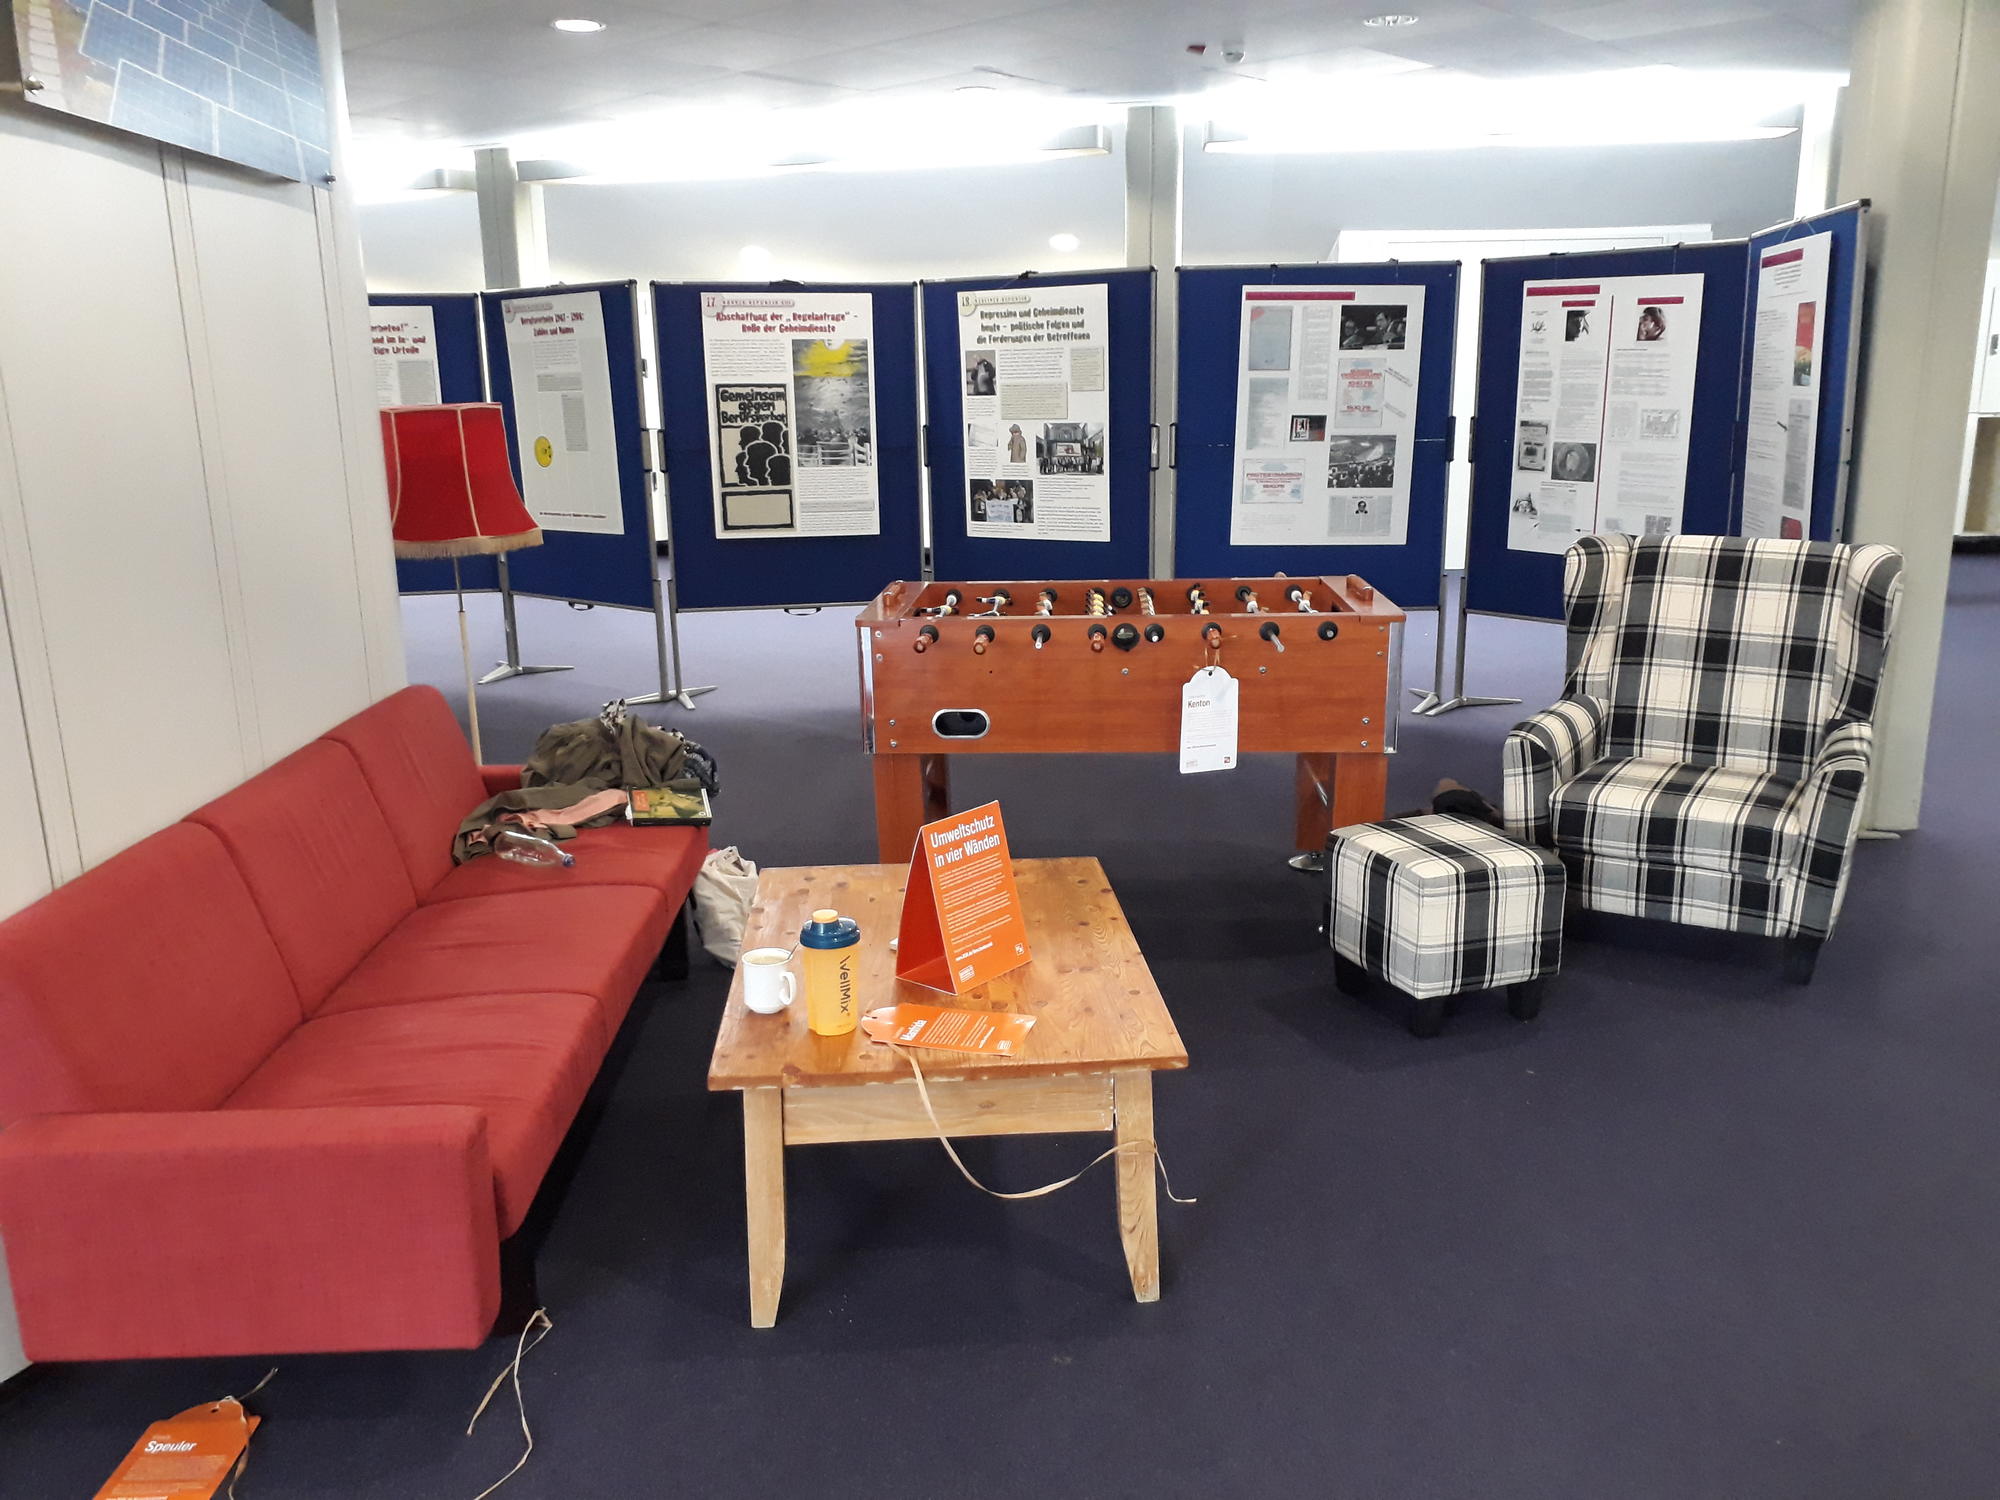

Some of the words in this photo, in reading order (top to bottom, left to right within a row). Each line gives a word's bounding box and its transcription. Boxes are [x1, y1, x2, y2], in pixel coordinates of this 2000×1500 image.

[706, 296, 716, 308] 17
[715, 311, 768, 322] Abschaffung
[770, 311, 783, 321] der
[1018, 307, 1031, 318] und
[1033, 306, 1085, 318] Geheimdienste
[763, 323, 777, 333] der
[779, 323, 836, 334] Geheimdienste
[980, 321, 1001, 332] heute
[1010, 320, 1045, 332] politische
[1046, 319, 1070, 331] Folgen
[1071, 319, 1085, 329] und
[412, 335, 427, 344] und
[976, 334, 987, 344] die
[988, 333, 1032, 345] Forderungen
[1033, 332, 1045, 343] der
[1046, 331, 1091, 343] Betroffenen
[720, 388, 785, 402] Gemeinsam
[738, 400, 776, 414] gegen
[1187, 699, 1211, 709] Kenton
[930, 814, 995, 849] Umweltschutz
[934, 853, 945, 868] in
[945, 848, 963, 864] vier
[963, 834, 1001, 857] Wänden
[144, 1440, 197, 1454] Speuler
